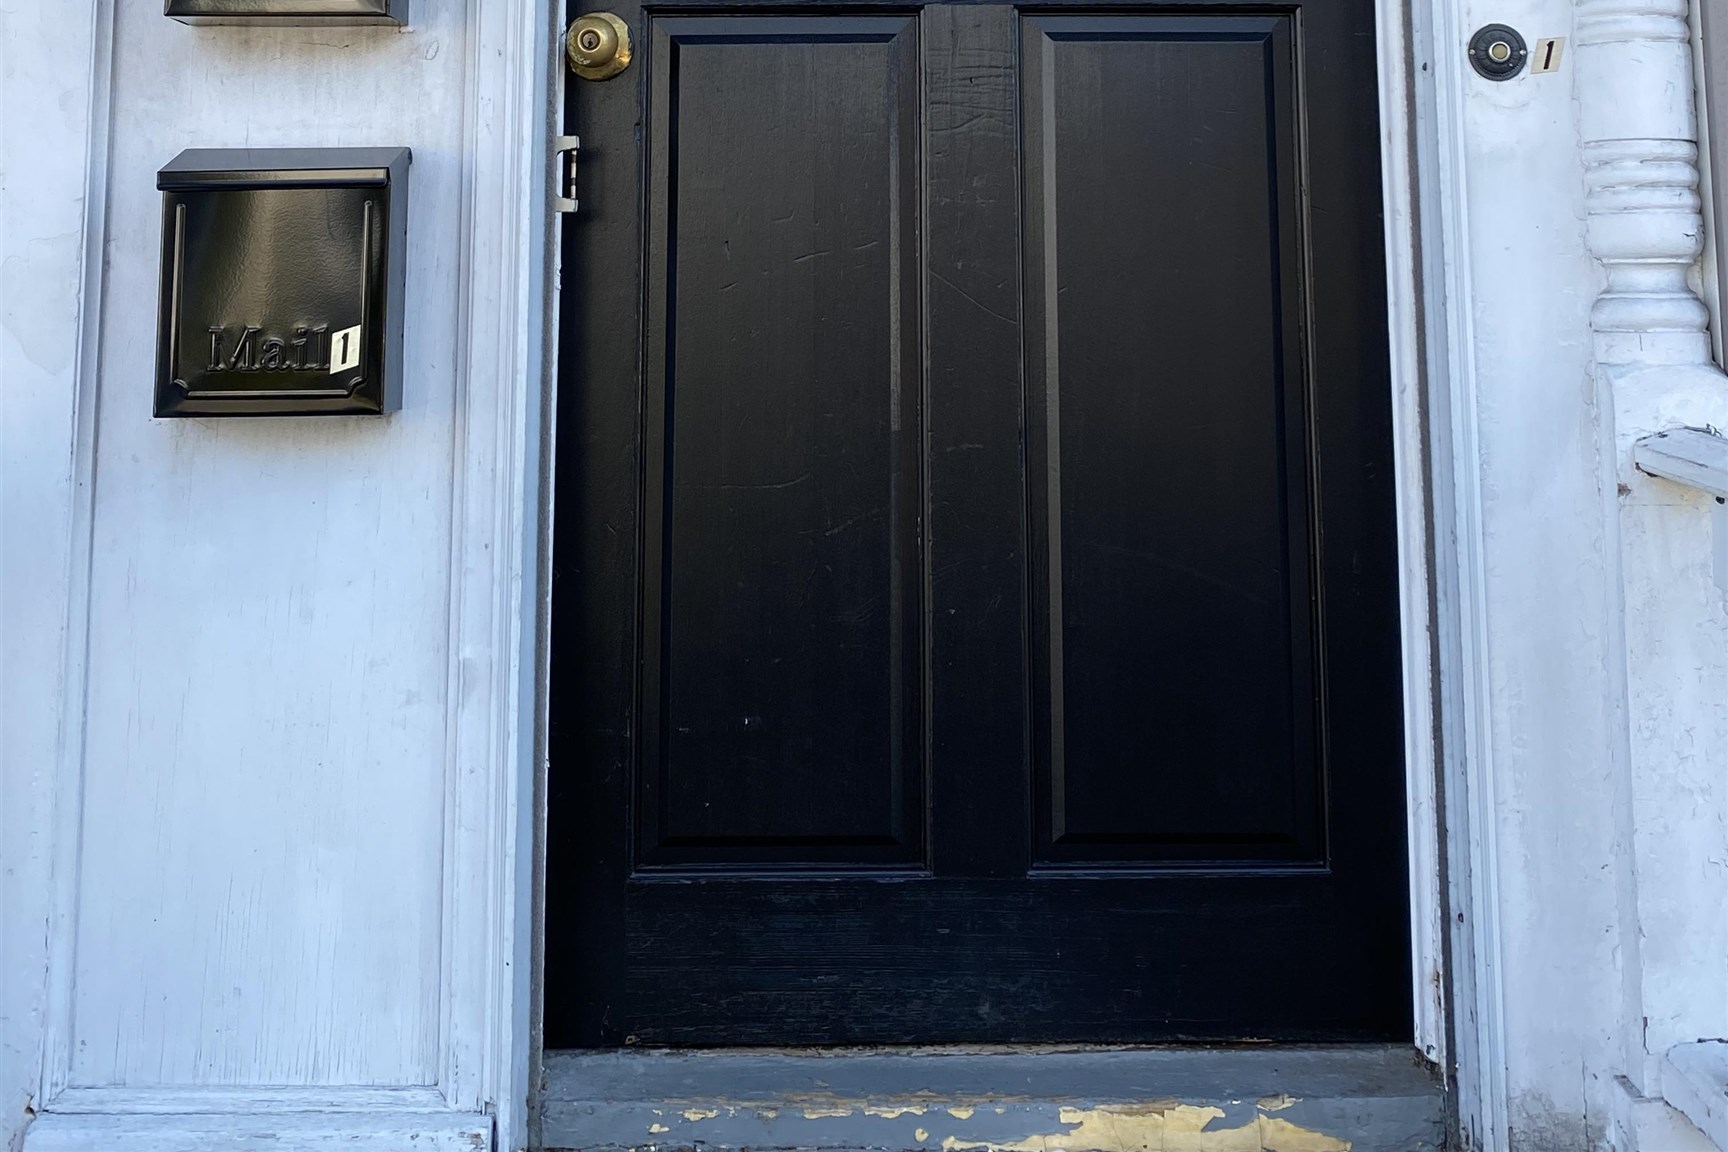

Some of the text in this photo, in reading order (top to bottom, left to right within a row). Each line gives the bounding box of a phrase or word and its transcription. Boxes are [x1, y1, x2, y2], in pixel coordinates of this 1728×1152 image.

[1543, 40, 1555, 70] 1
[207, 324, 350, 371] Mail 1
